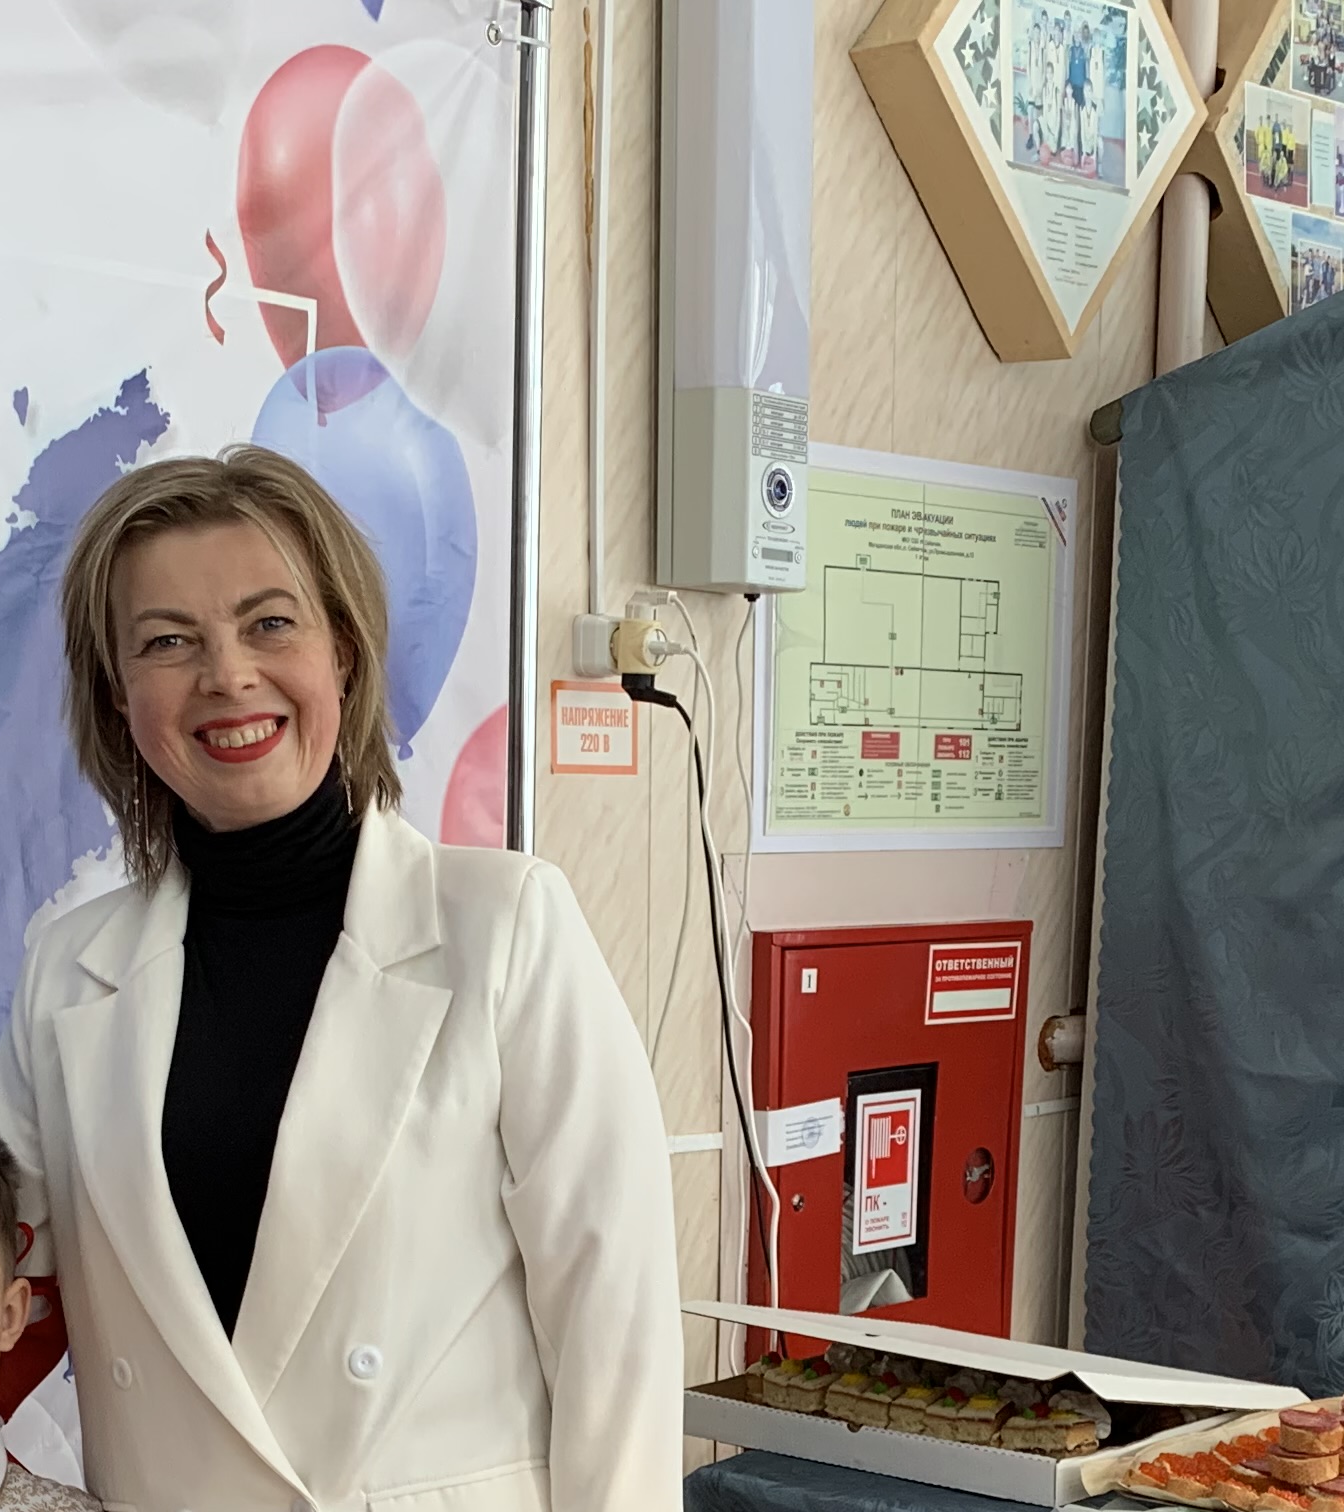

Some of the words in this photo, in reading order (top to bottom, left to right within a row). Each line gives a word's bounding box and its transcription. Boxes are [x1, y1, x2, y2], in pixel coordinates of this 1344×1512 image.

[891, 509, 910, 520] ПЛАН
[911, 511, 954, 525] ЭВАКУАЦИИ
[868, 521, 881, 531] при
[882, 523, 906, 533] пожаре
[561, 706, 629, 727] НАПРЯЖЕНИЕ
[580, 733, 599, 752] 220
[603, 734, 610, 753] В
[935, 955, 1014, 971] ОТВЕТСТВЕННЫЙ
[807, 974, 811, 989] 1
[865, 1194, 880, 1212] ПК
